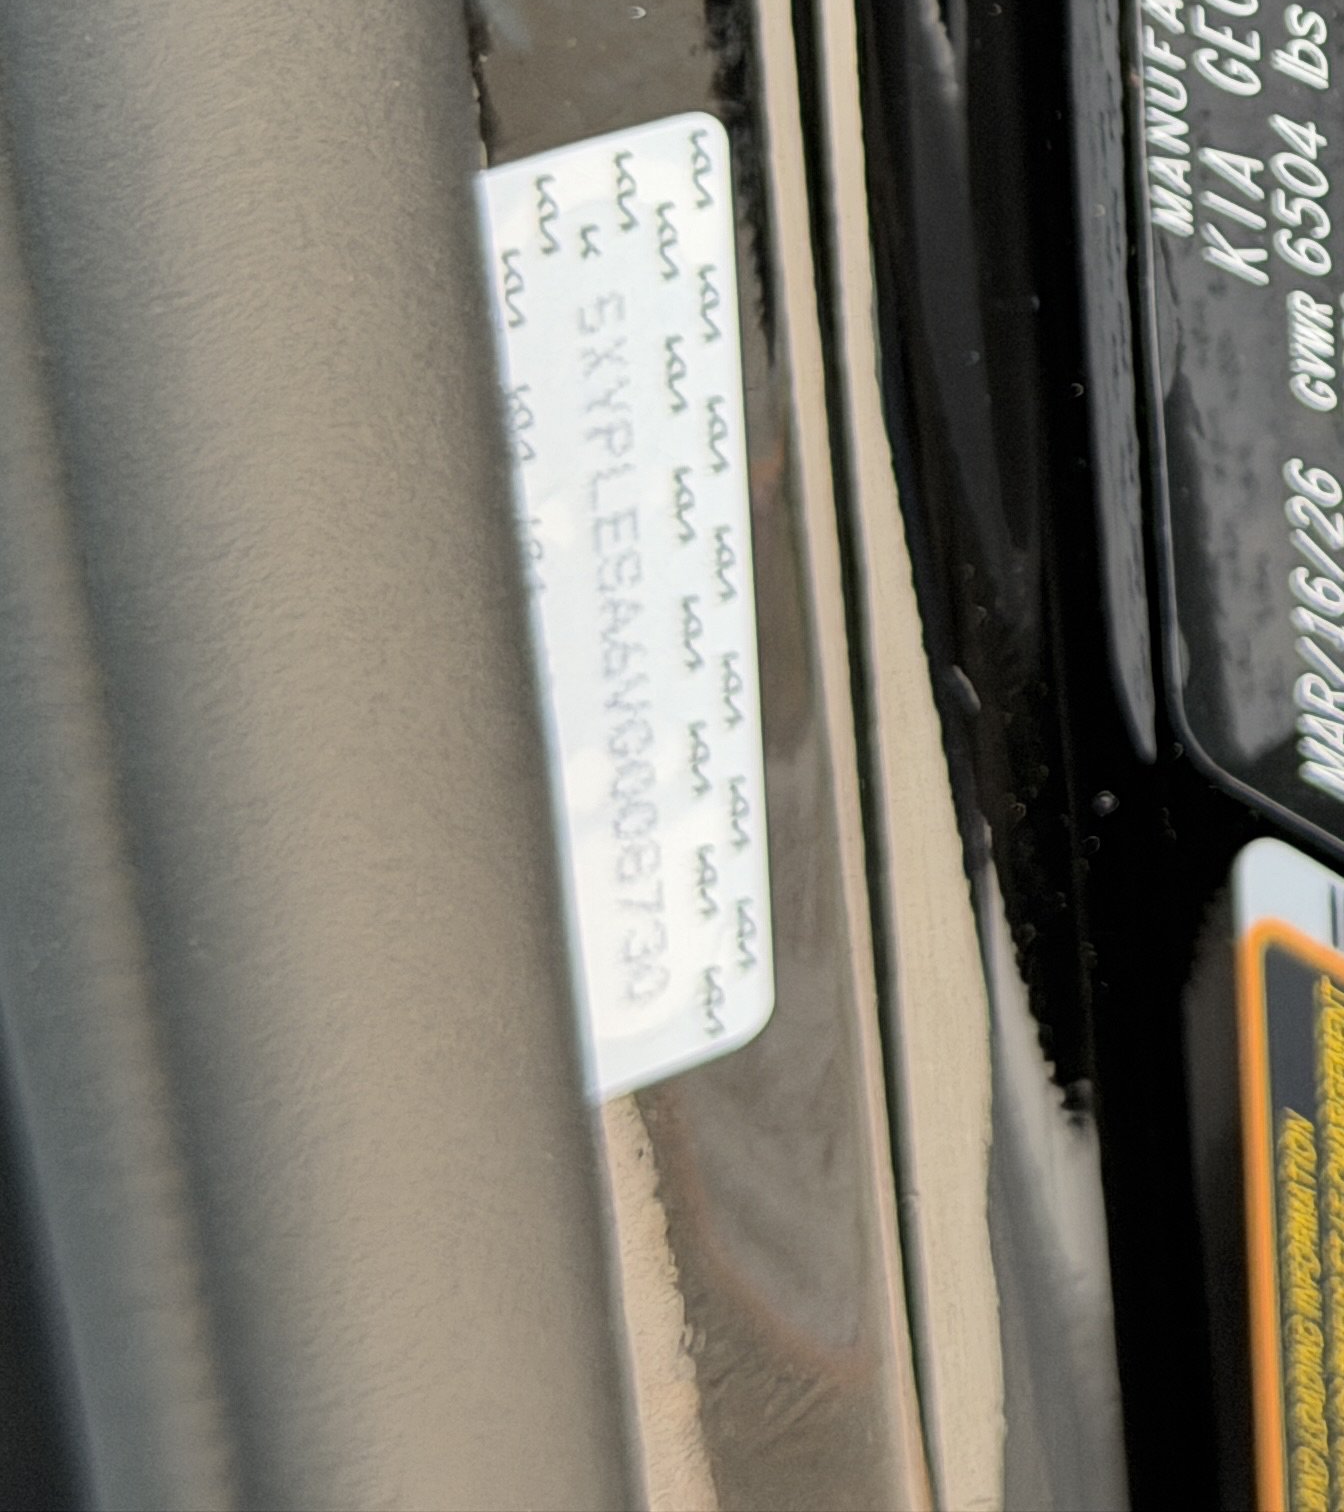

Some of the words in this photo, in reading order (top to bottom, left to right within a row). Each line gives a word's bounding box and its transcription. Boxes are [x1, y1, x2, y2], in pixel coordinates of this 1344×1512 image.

[1270, 4, 1330, 90] lbs
[1196, 146, 1270, 286] KIA
[1268, 113, 1332, 276] 6504
[1286, 289, 1338, 412] GVWR
[1279, 1106, 1325, 1320] INFORMATION
[1287, 1315, 1329, 1456] LOADING
